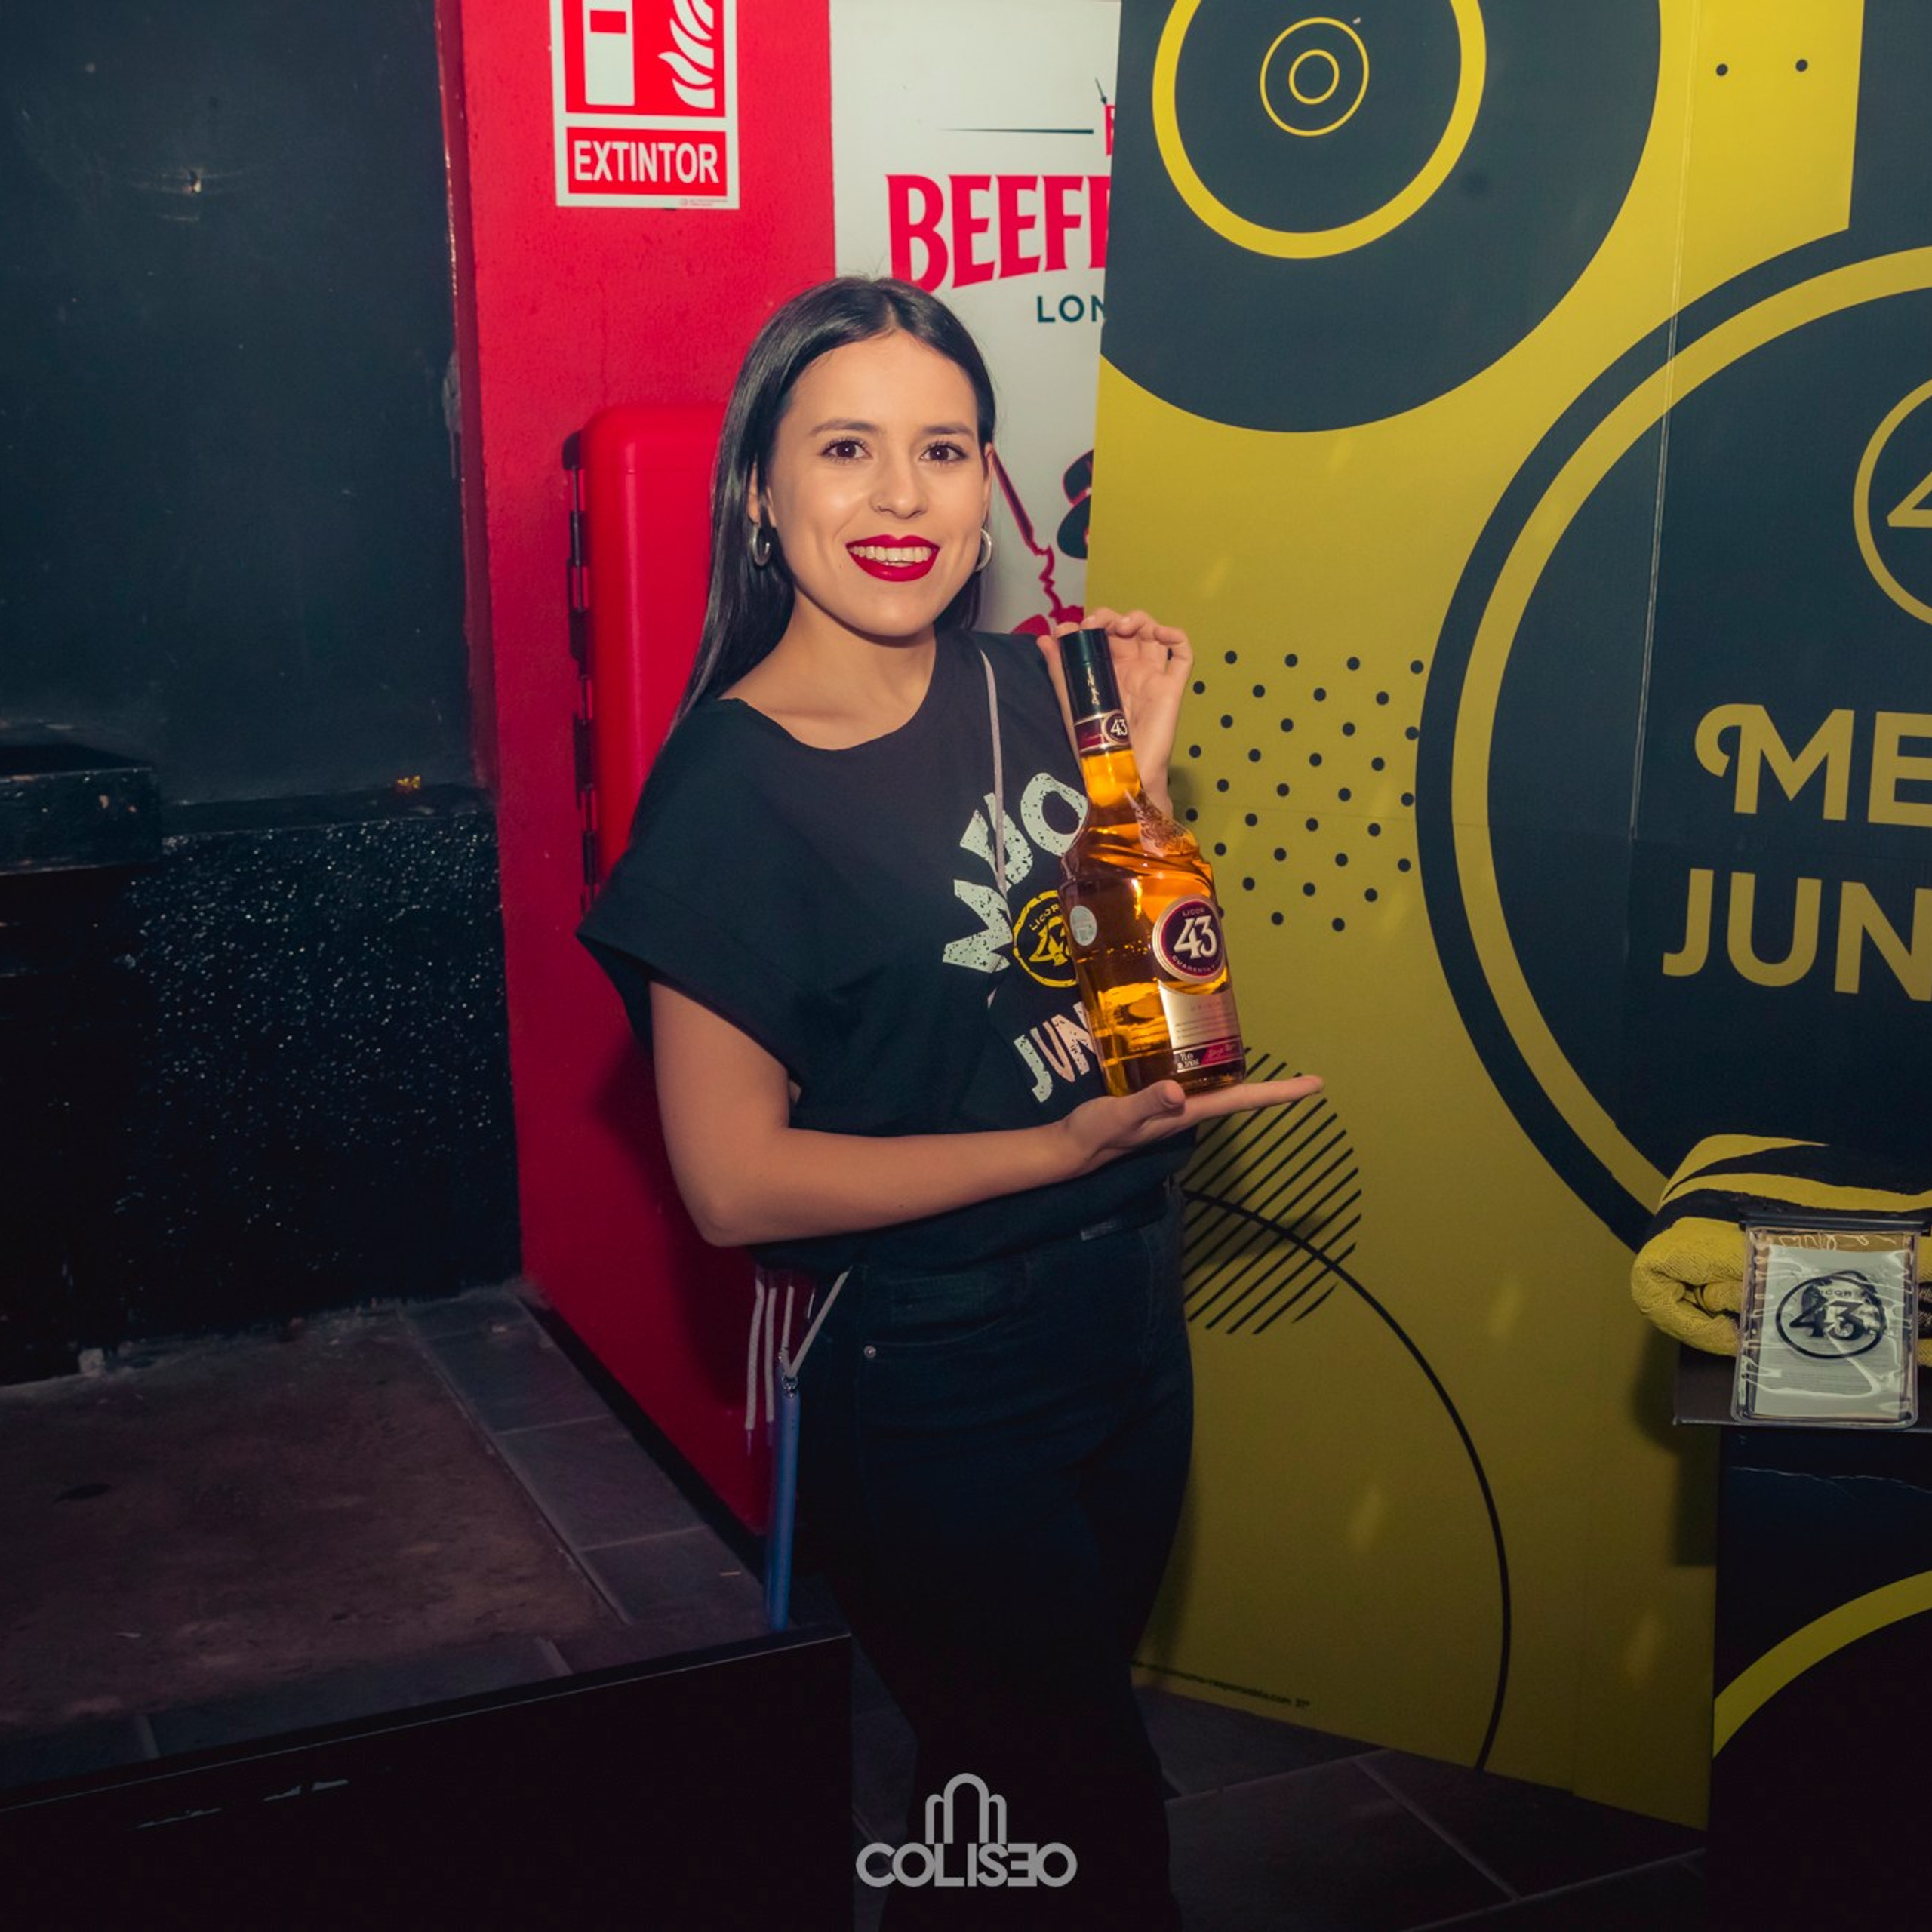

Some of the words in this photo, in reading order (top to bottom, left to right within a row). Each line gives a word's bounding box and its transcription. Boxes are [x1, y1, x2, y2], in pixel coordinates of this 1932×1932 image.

[574, 140, 720, 183] EXTINTOR
[1110, 718, 1128, 737] 43
[1694, 703, 1932, 828] ME
[1174, 915, 1217, 959] 43
[1663, 868, 1932, 1002] JUN
